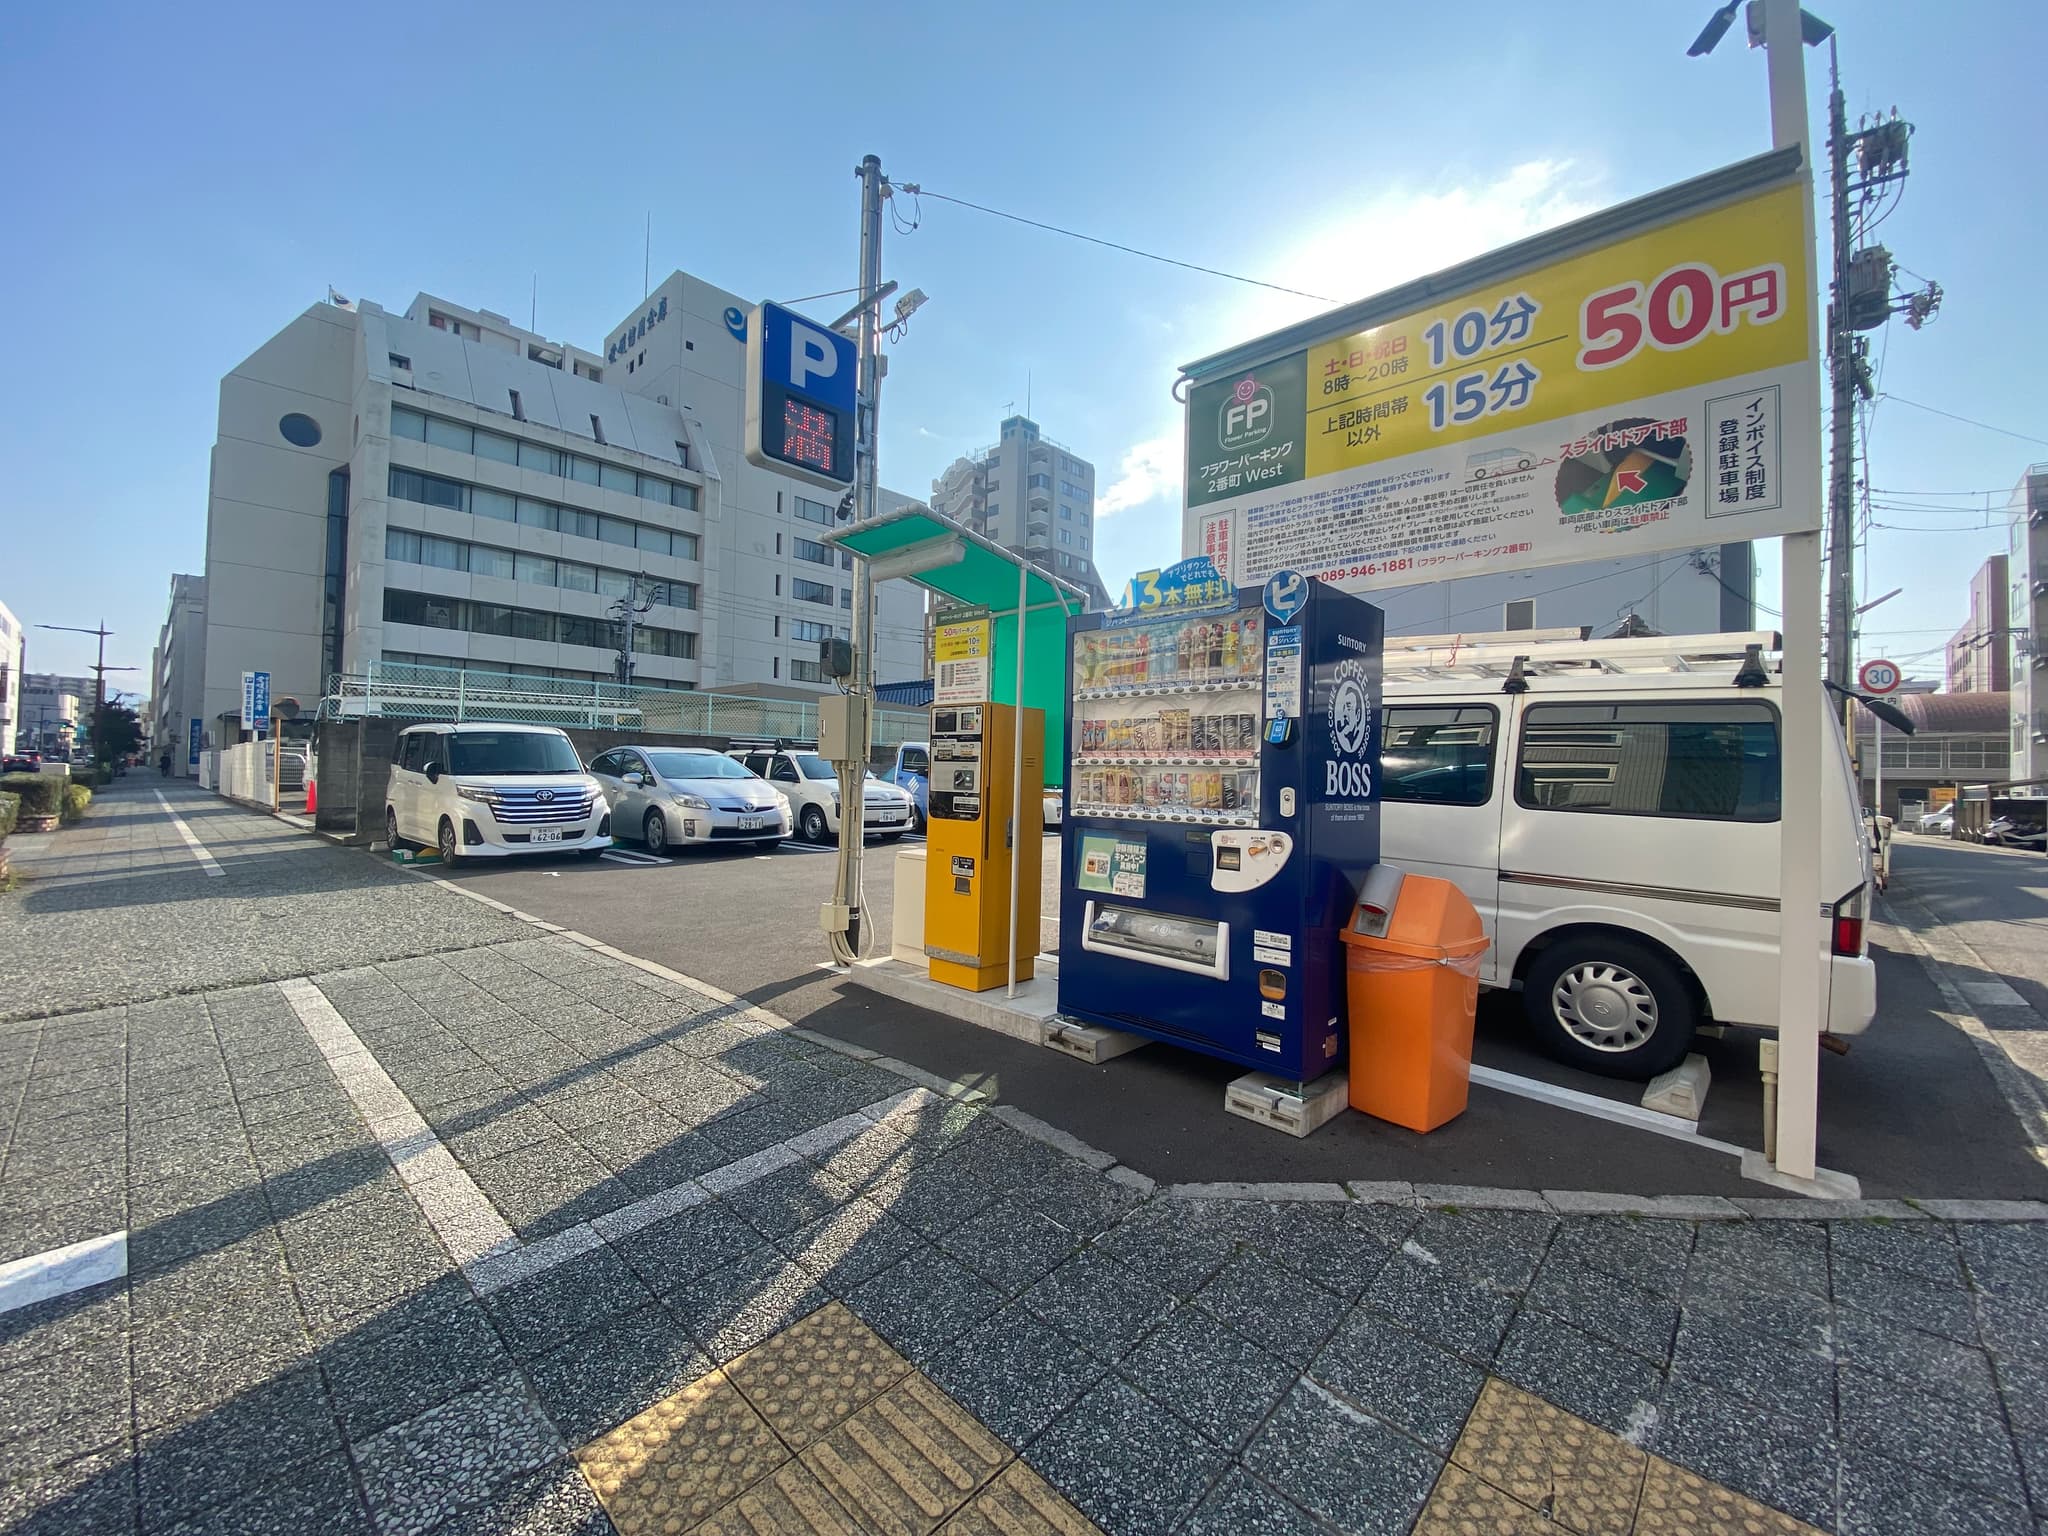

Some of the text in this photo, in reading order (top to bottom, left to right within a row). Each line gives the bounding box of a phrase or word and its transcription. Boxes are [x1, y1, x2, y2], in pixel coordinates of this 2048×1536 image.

[1425, 296, 1537, 366] 10分
[1582, 268, 1778, 367] 50円
[790, 321, 838, 388] P
[1323, 335, 1407, 377] 土・日・祝日
[1425, 363, 1537, 428] 15分
[1226, 398, 1268, 435] FP
[1244, 427, 1267, 439] Parking
[1322, 396, 1408, 435] 上記時間帯
[784, 400, 833, 471] 満
[1346, 424, 1382, 447] 以外
[1559, 417, 1688, 459] スライドドア下部
[1745, 397, 1766, 501] インボイス制度
[1200, 441, 1293, 478] フラワーパーキング
[1208, 462, 1283, 493] 2番町 West
[1719, 419, 1739, 504] 登録駐車場
[1559, 496, 1688, 525] 車両底部よりスライドドア下部
[1574, 511, 1670, 534] が低い車両は駐車禁止
[1181, 571, 1215, 582] でどれでも
[1321, 557, 1414, 582] 089-946-1881
[1338, 634, 1367, 653] SUNTORY
[1334, 659, 1368, 691] COFFEE
[1869, 669, 1892, 684] 30
[1325, 760, 1371, 797] BOSS
[537, 832, 561, 842] 62-06
[1114, 853, 1146, 864] キャンペーン
